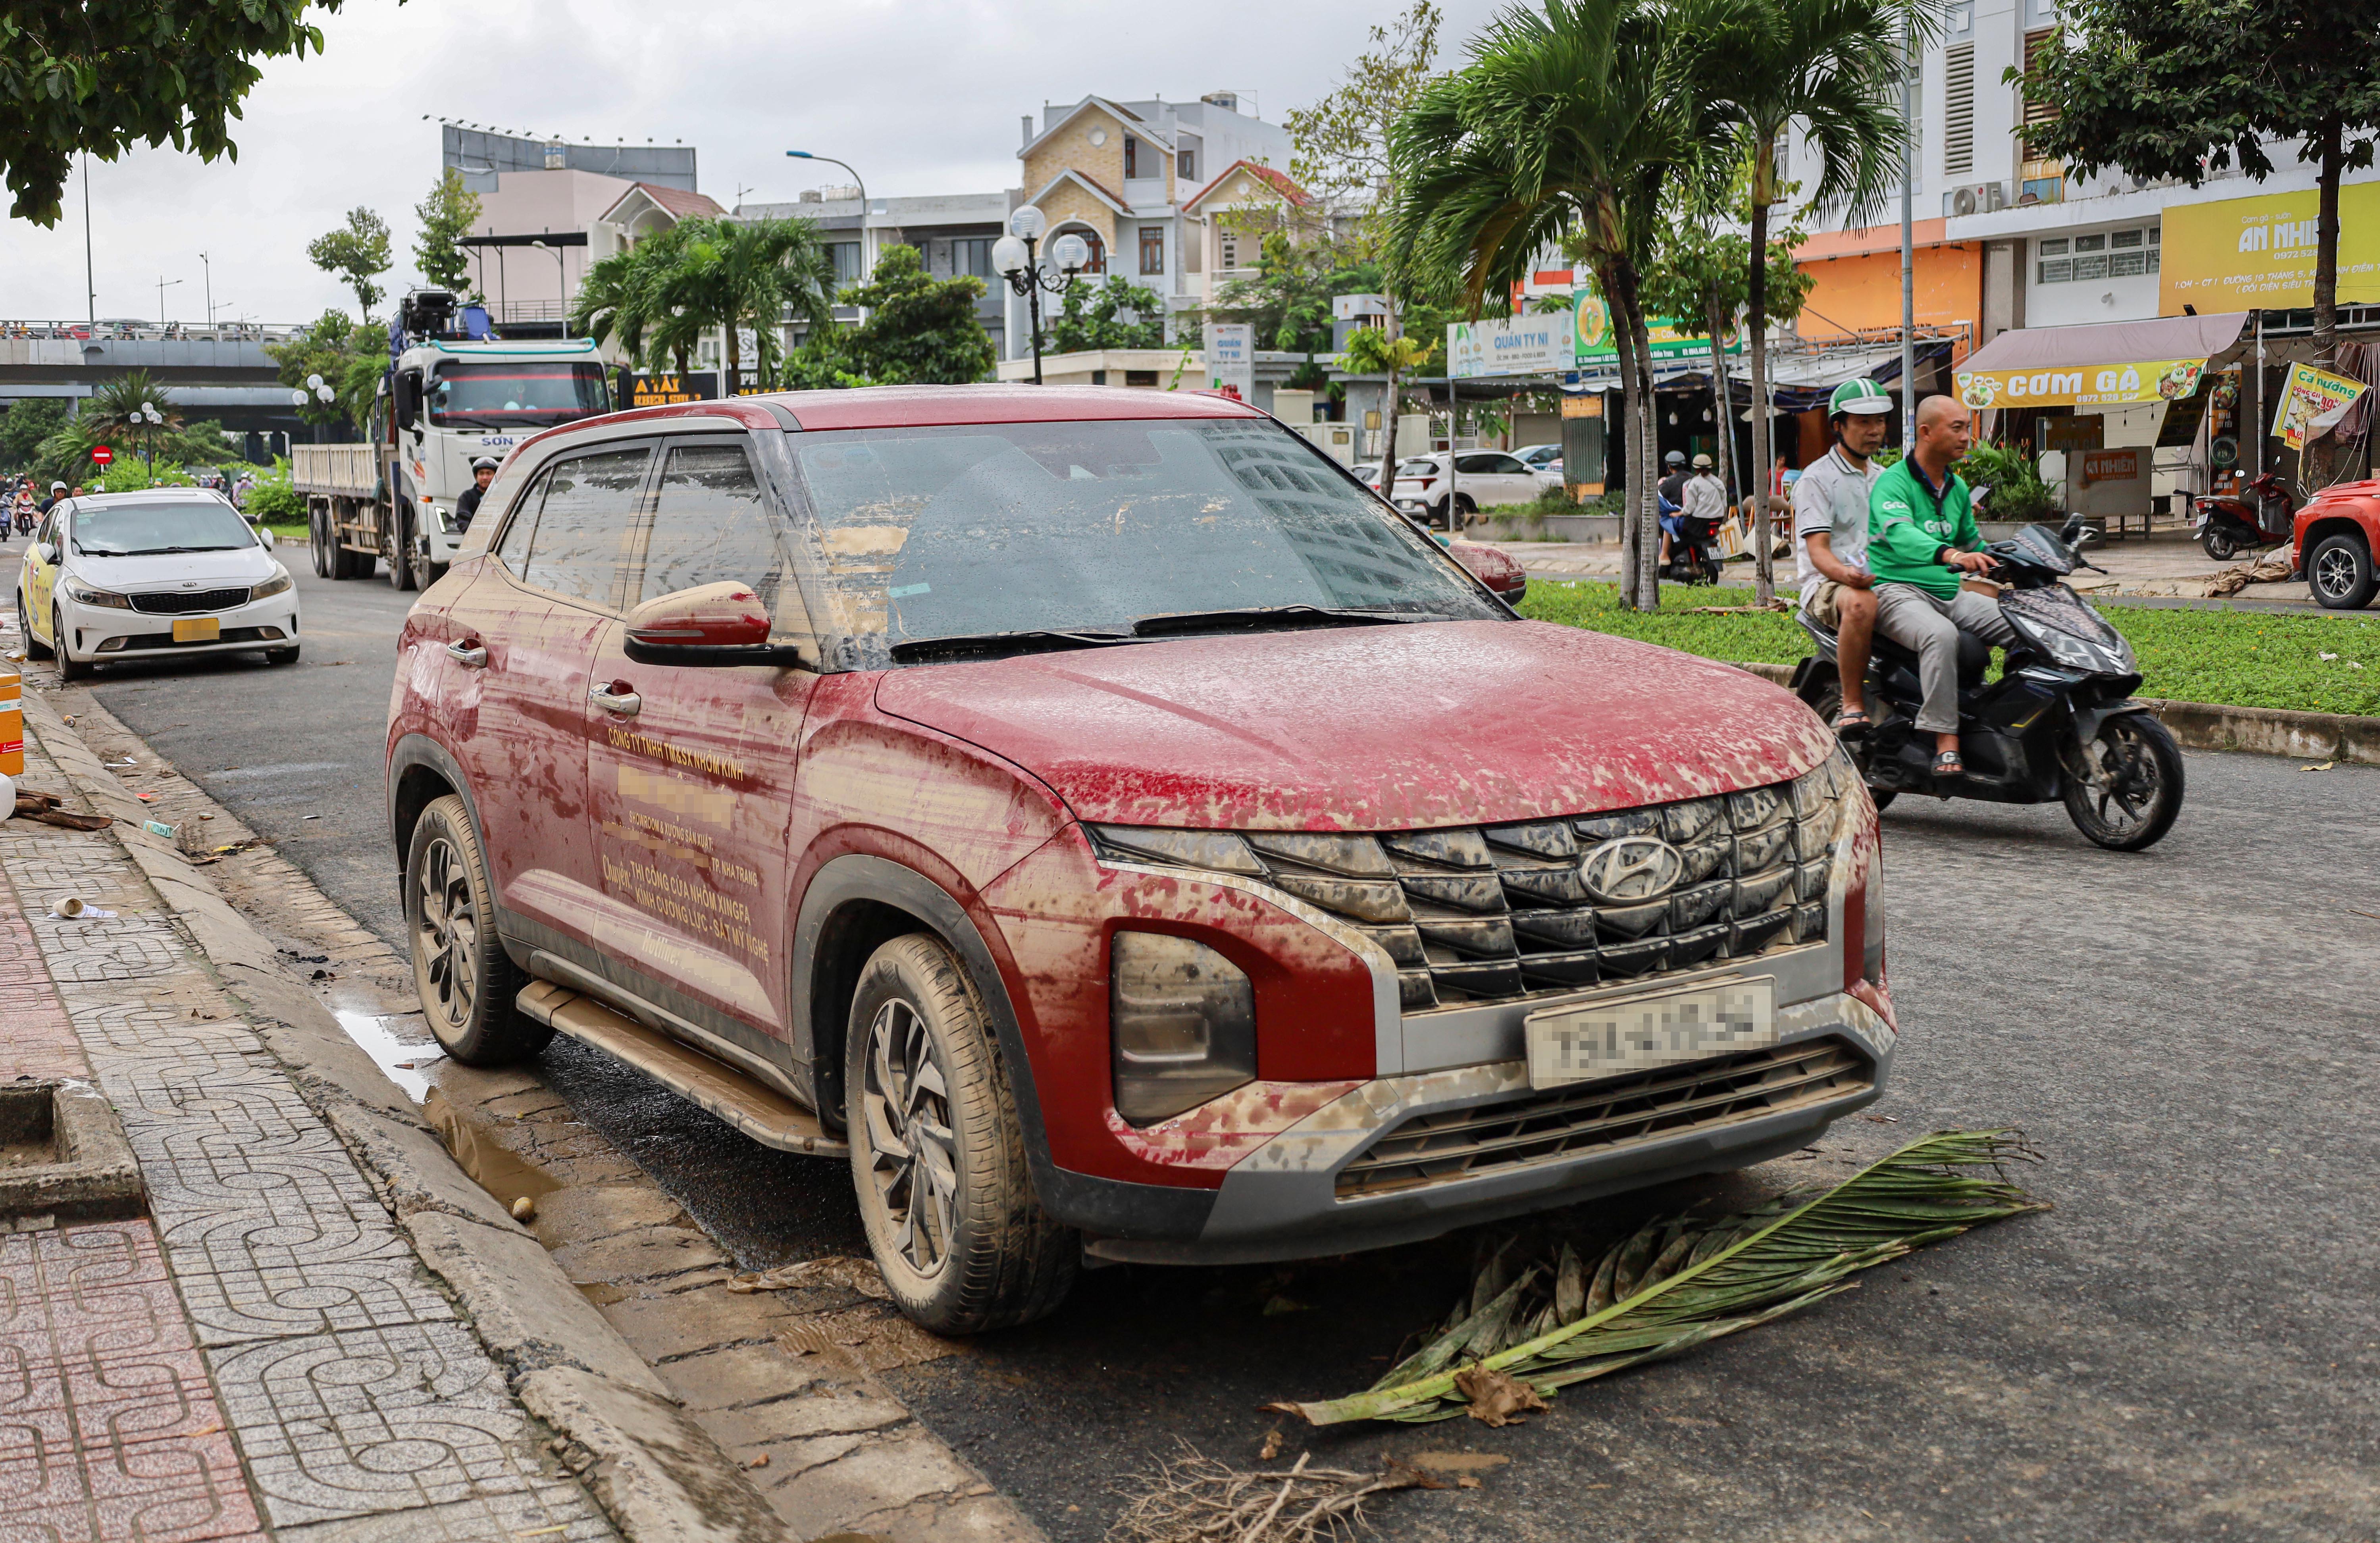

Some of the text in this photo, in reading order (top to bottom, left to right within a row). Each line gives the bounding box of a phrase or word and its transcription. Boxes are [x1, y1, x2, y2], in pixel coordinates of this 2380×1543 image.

[2239, 225, 2268, 253] AN
[2274, 250, 2298, 260] 0972
[2175, 279, 2193, 289] 1.04
[2255, 274, 2264, 282] 19
[2267, 269, 2294, 280] THÁNG
[2303, 279, 2315, 288] TH
[1217, 337, 1242, 347] QUÁN
[1494, 331, 1548, 349] QUÁN TY NI
[2007, 365, 2140, 397] CƠM GÀ
[2298, 371, 2315, 383] Cá
[2076, 394, 2099, 403] 0972
[2122, 392, 2139, 401] 527
[2101, 456, 2135, 474] NHIÊN
[608, 724, 743, 782] CÔNG TY TNHH TM&SX NHÔM KÍNH
[629, 810, 660, 832] SHOWROOM
[660, 823, 664, 833] &
[711, 857, 757, 887] TP. NHA TRANG
[630, 861, 645, 882] THI
[645, 864, 669, 891] CÔNG
[670, 875, 690, 900] CỬA
[690, 885, 716, 911] NHÔM
[717, 894, 751, 926] XINGFA
[635, 886, 656, 910] KÍNH
[641, 930, 680, 966] Hotline:
